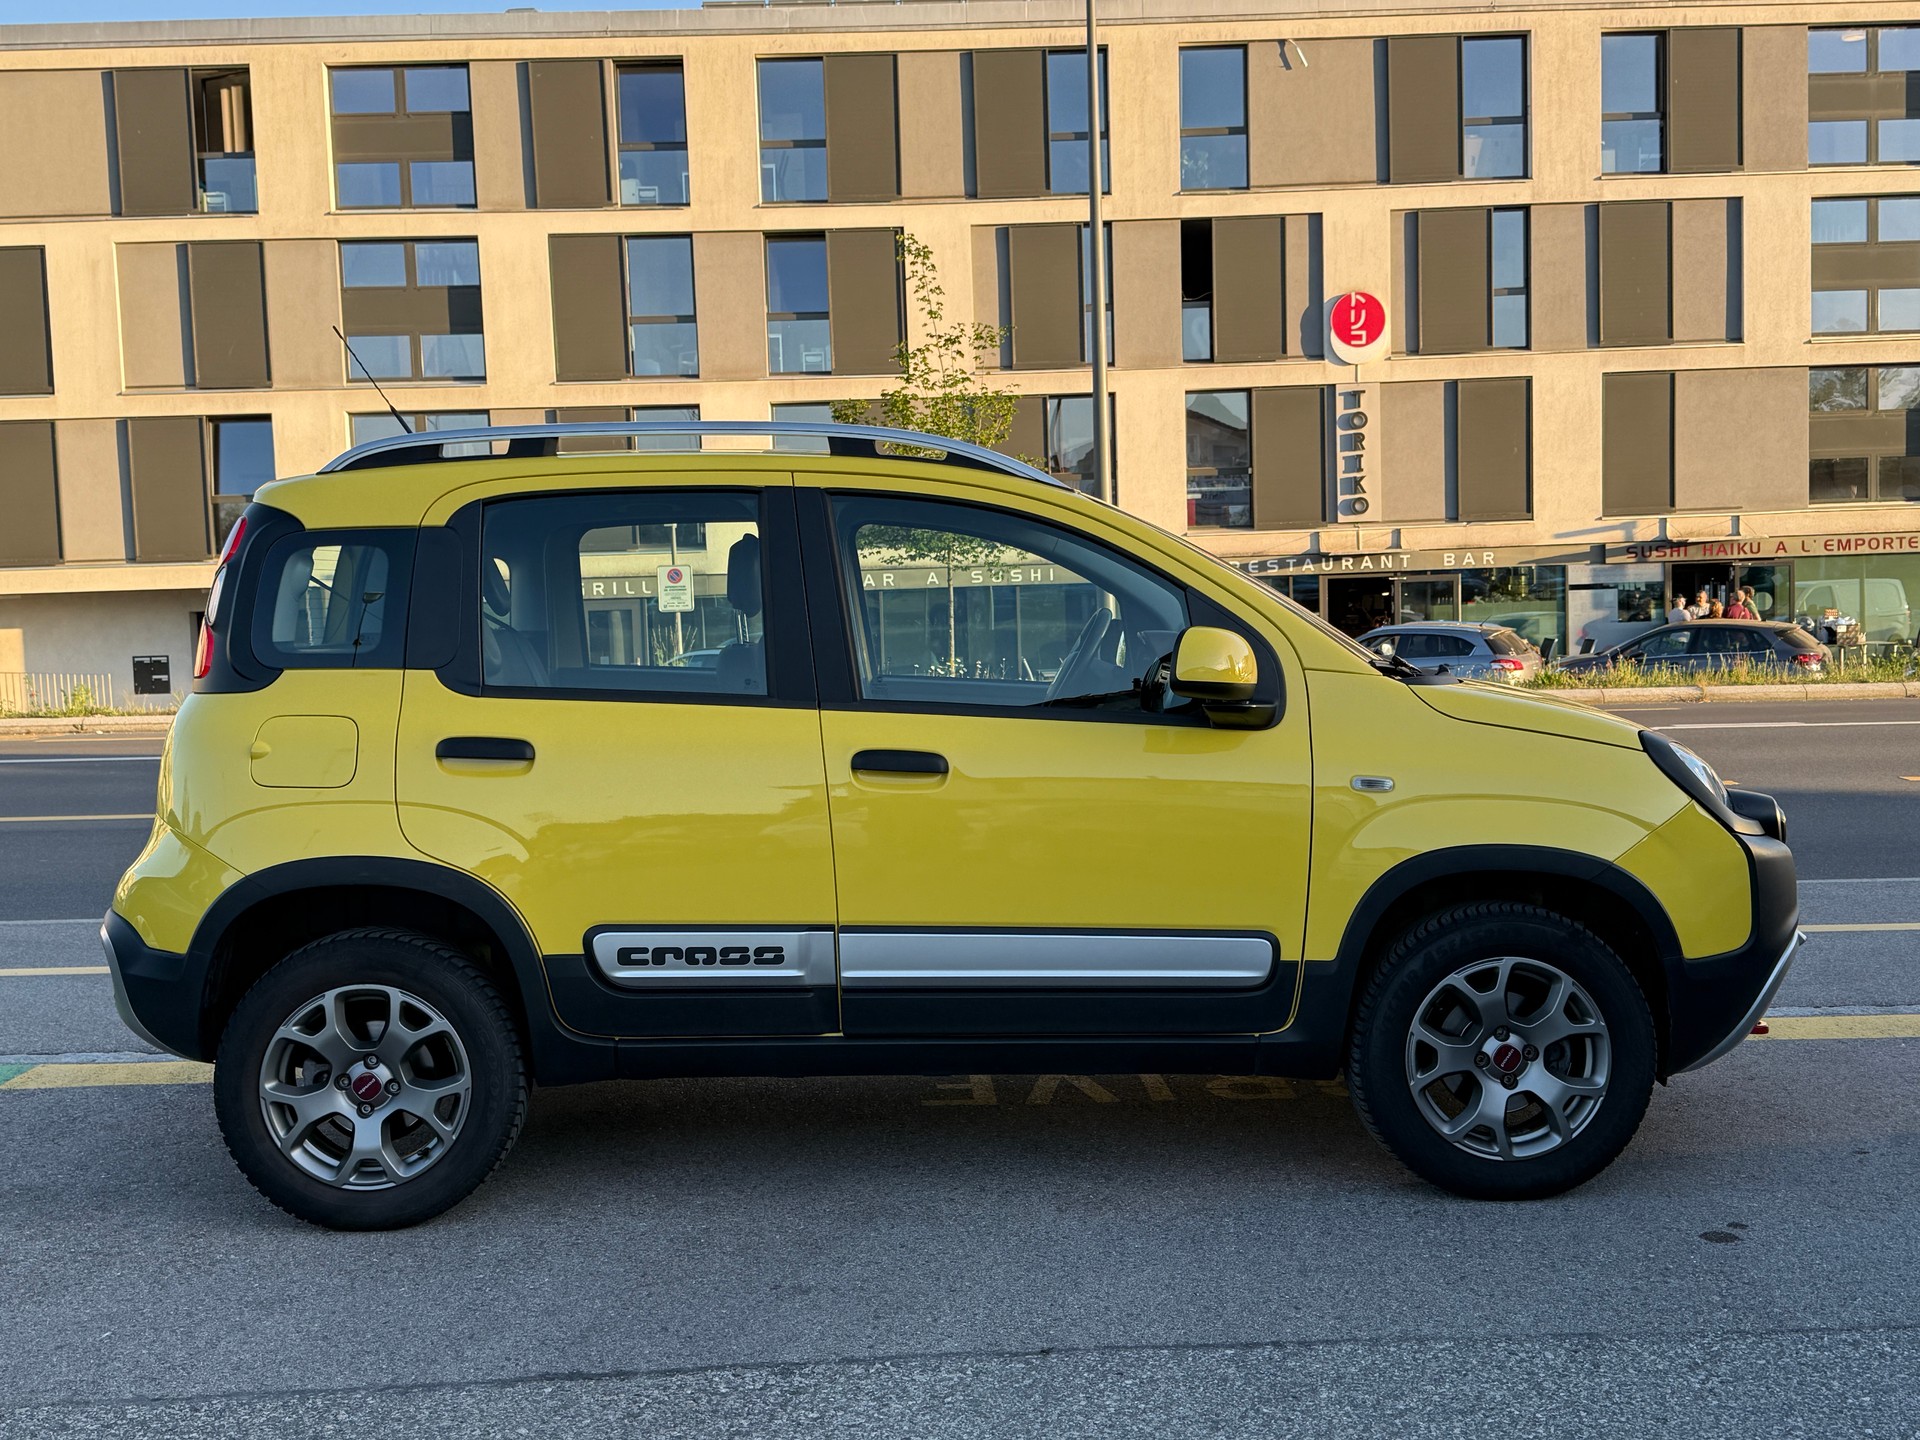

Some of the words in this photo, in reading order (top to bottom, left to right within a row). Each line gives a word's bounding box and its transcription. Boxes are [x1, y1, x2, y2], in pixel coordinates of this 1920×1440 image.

[1350, 291, 1367, 346] トリコ
[1346, 389, 1369, 515] TORIKO
[1443, 551, 1495, 567] BAR
[1625, 545, 1688, 559] SUSHI
[1702, 541, 1761, 556] HAIKU
[1774, 540, 1788, 554] A
[926, 572, 939, 585] A
[970, 568, 1054, 584] SUSHI
[582, 581, 652, 596] RILL
[617, 946, 785, 966] cross
